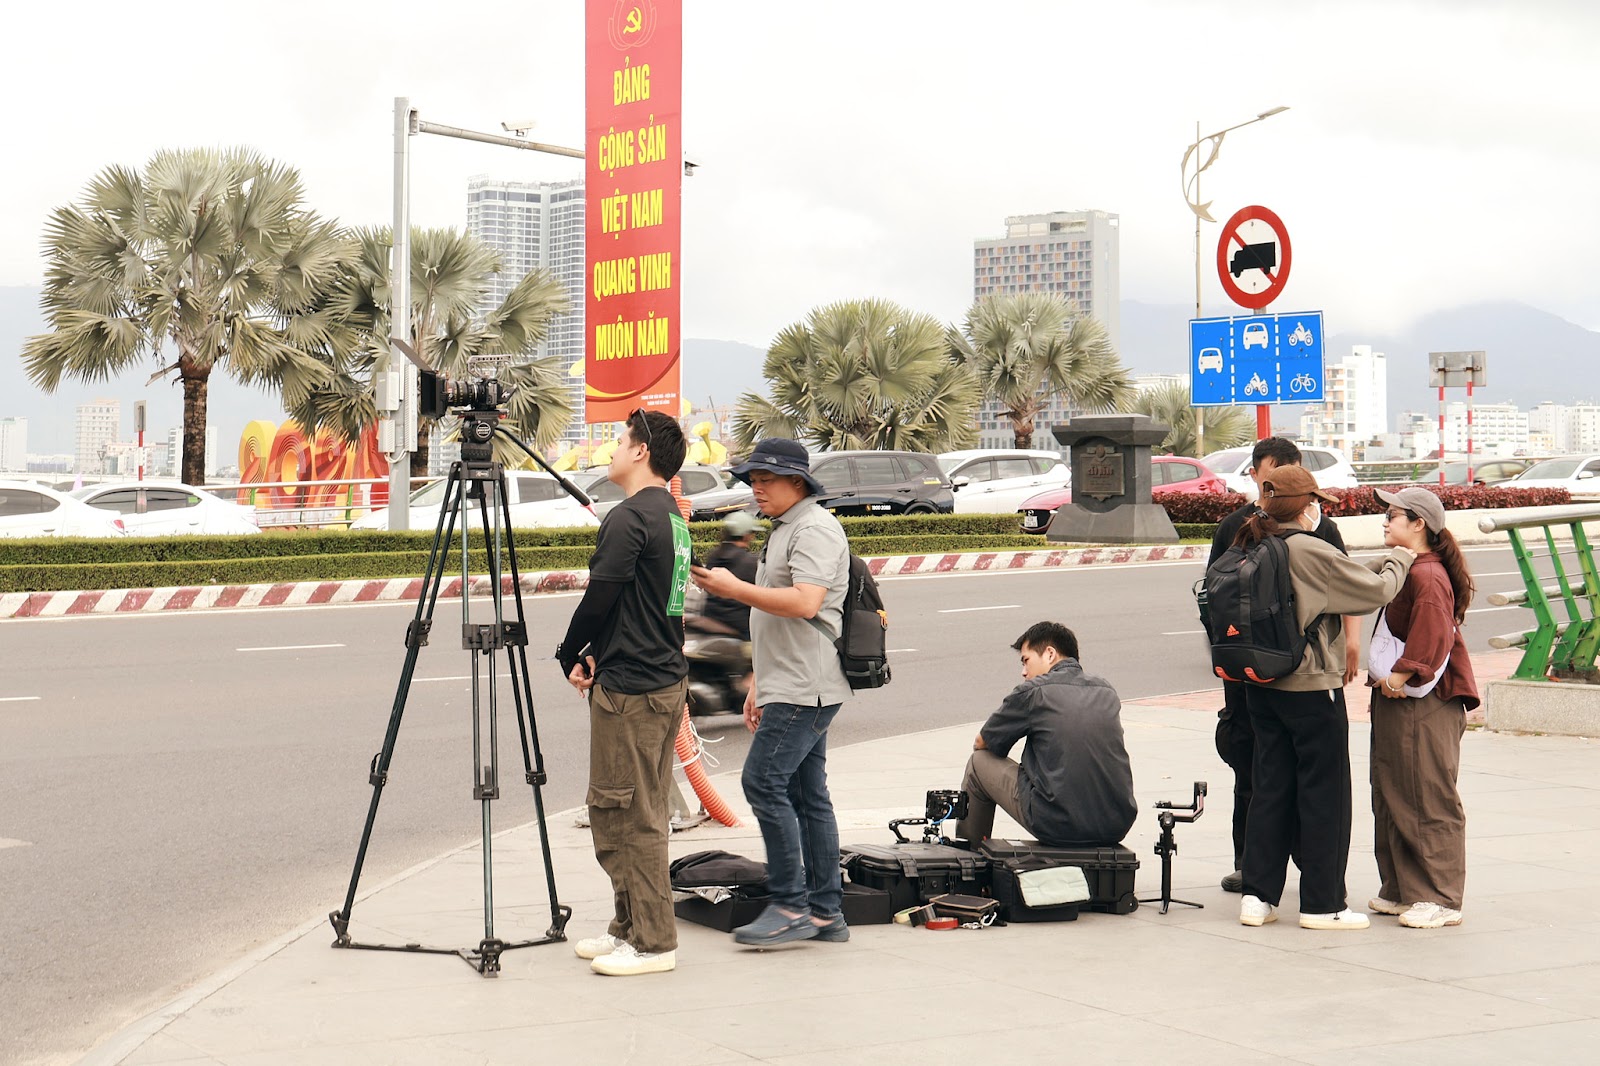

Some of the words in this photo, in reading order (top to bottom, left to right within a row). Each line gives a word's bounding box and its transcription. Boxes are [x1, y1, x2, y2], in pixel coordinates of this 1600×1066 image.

[613, 55, 650, 106] ĐẢNG
[599, 126, 634, 177] CỘNG
[638, 113, 666, 164] SẢN
[601, 188, 628, 239] VIỆT
[631, 189, 663, 229] NAM
[593, 257, 636, 302] QUANG
[639, 252, 671, 291] VINH
[595, 314, 634, 361] MUÔN
[637, 311, 668, 356] NĂM
